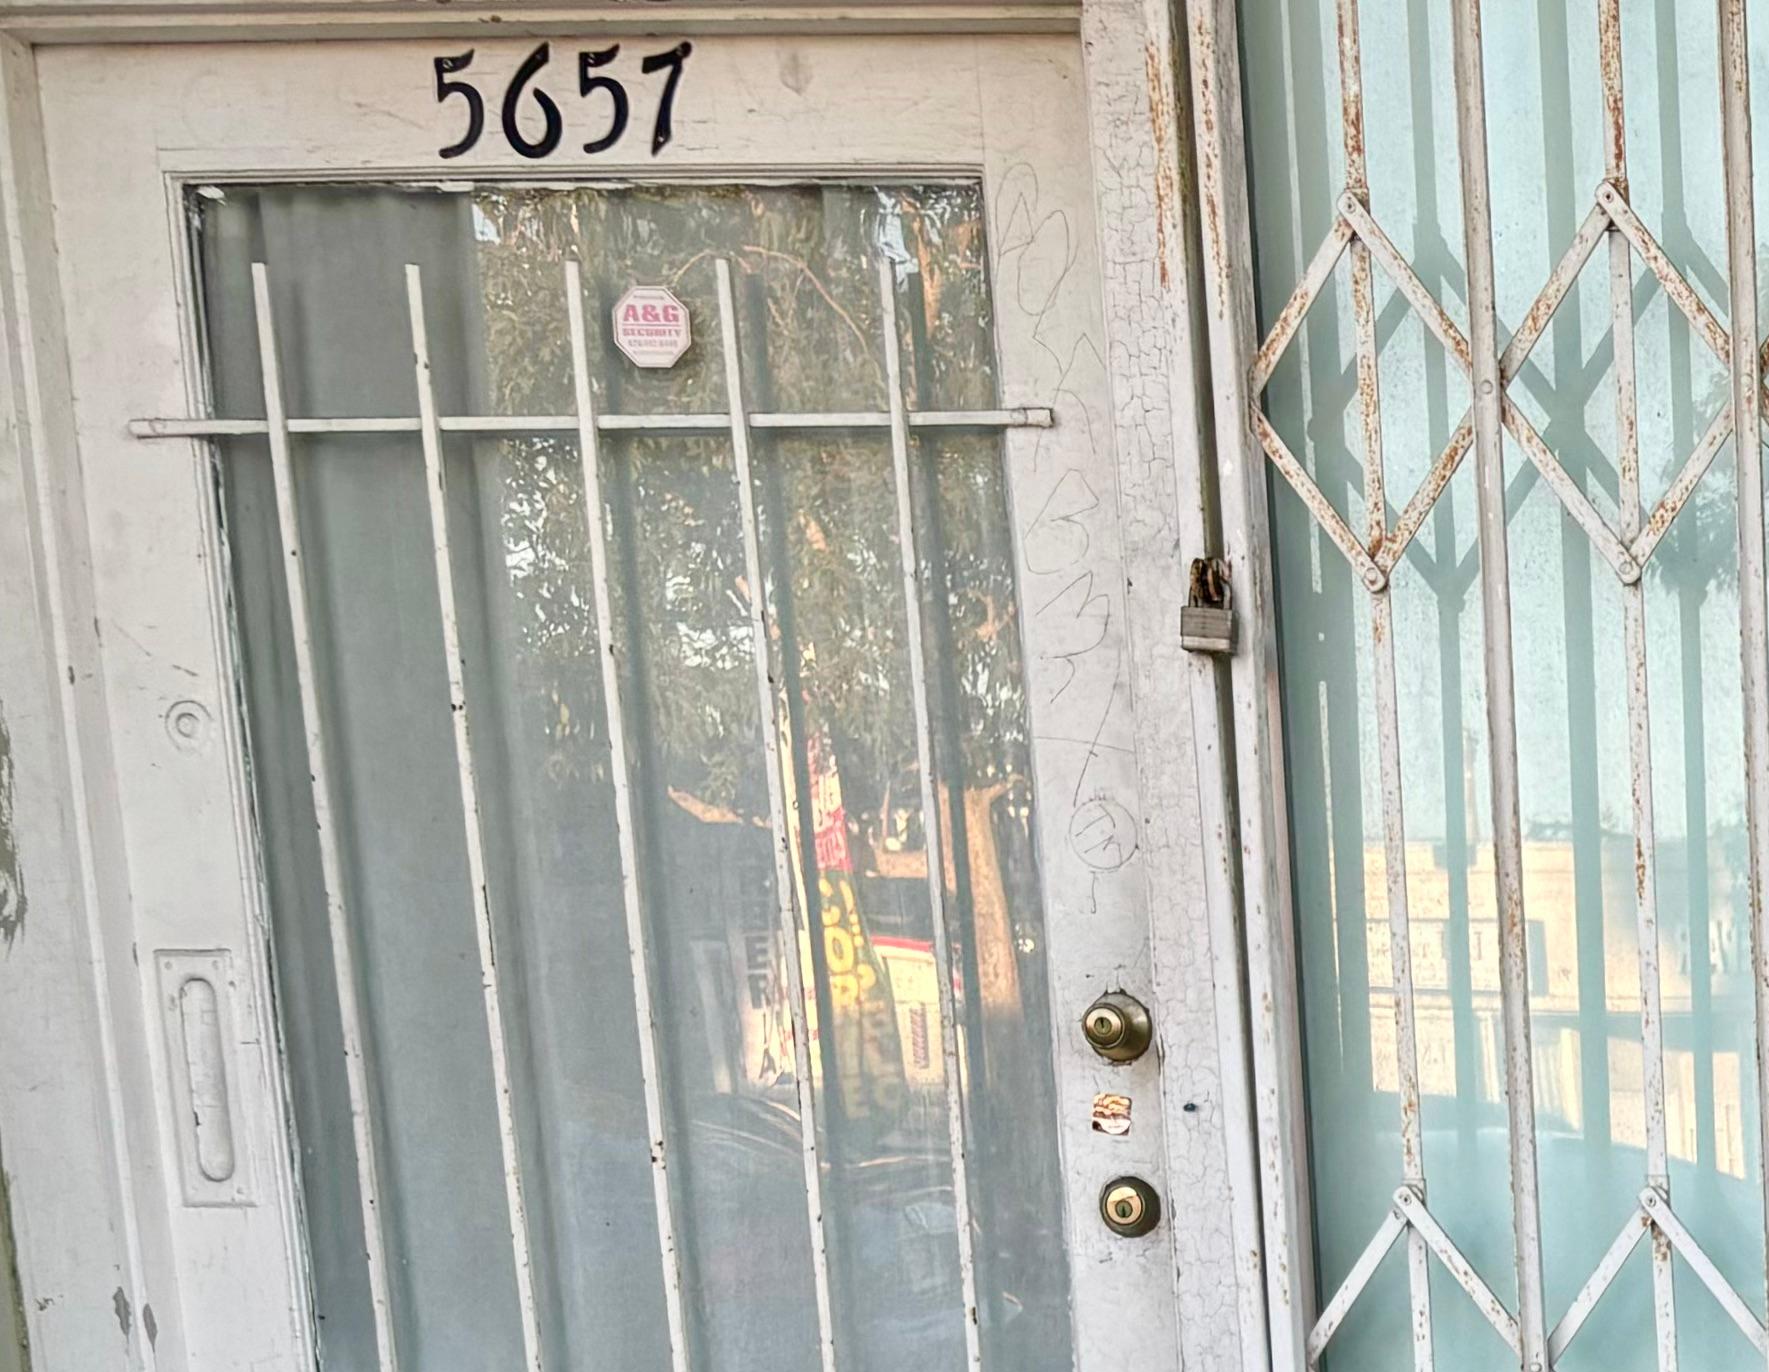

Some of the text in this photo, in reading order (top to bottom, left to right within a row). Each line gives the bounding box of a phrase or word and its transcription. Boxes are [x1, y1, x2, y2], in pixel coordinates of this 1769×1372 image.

[434, 41, 691, 159] 5657
[623, 304, 679, 322] A&G
[623, 328, 682, 337] SECURITY
